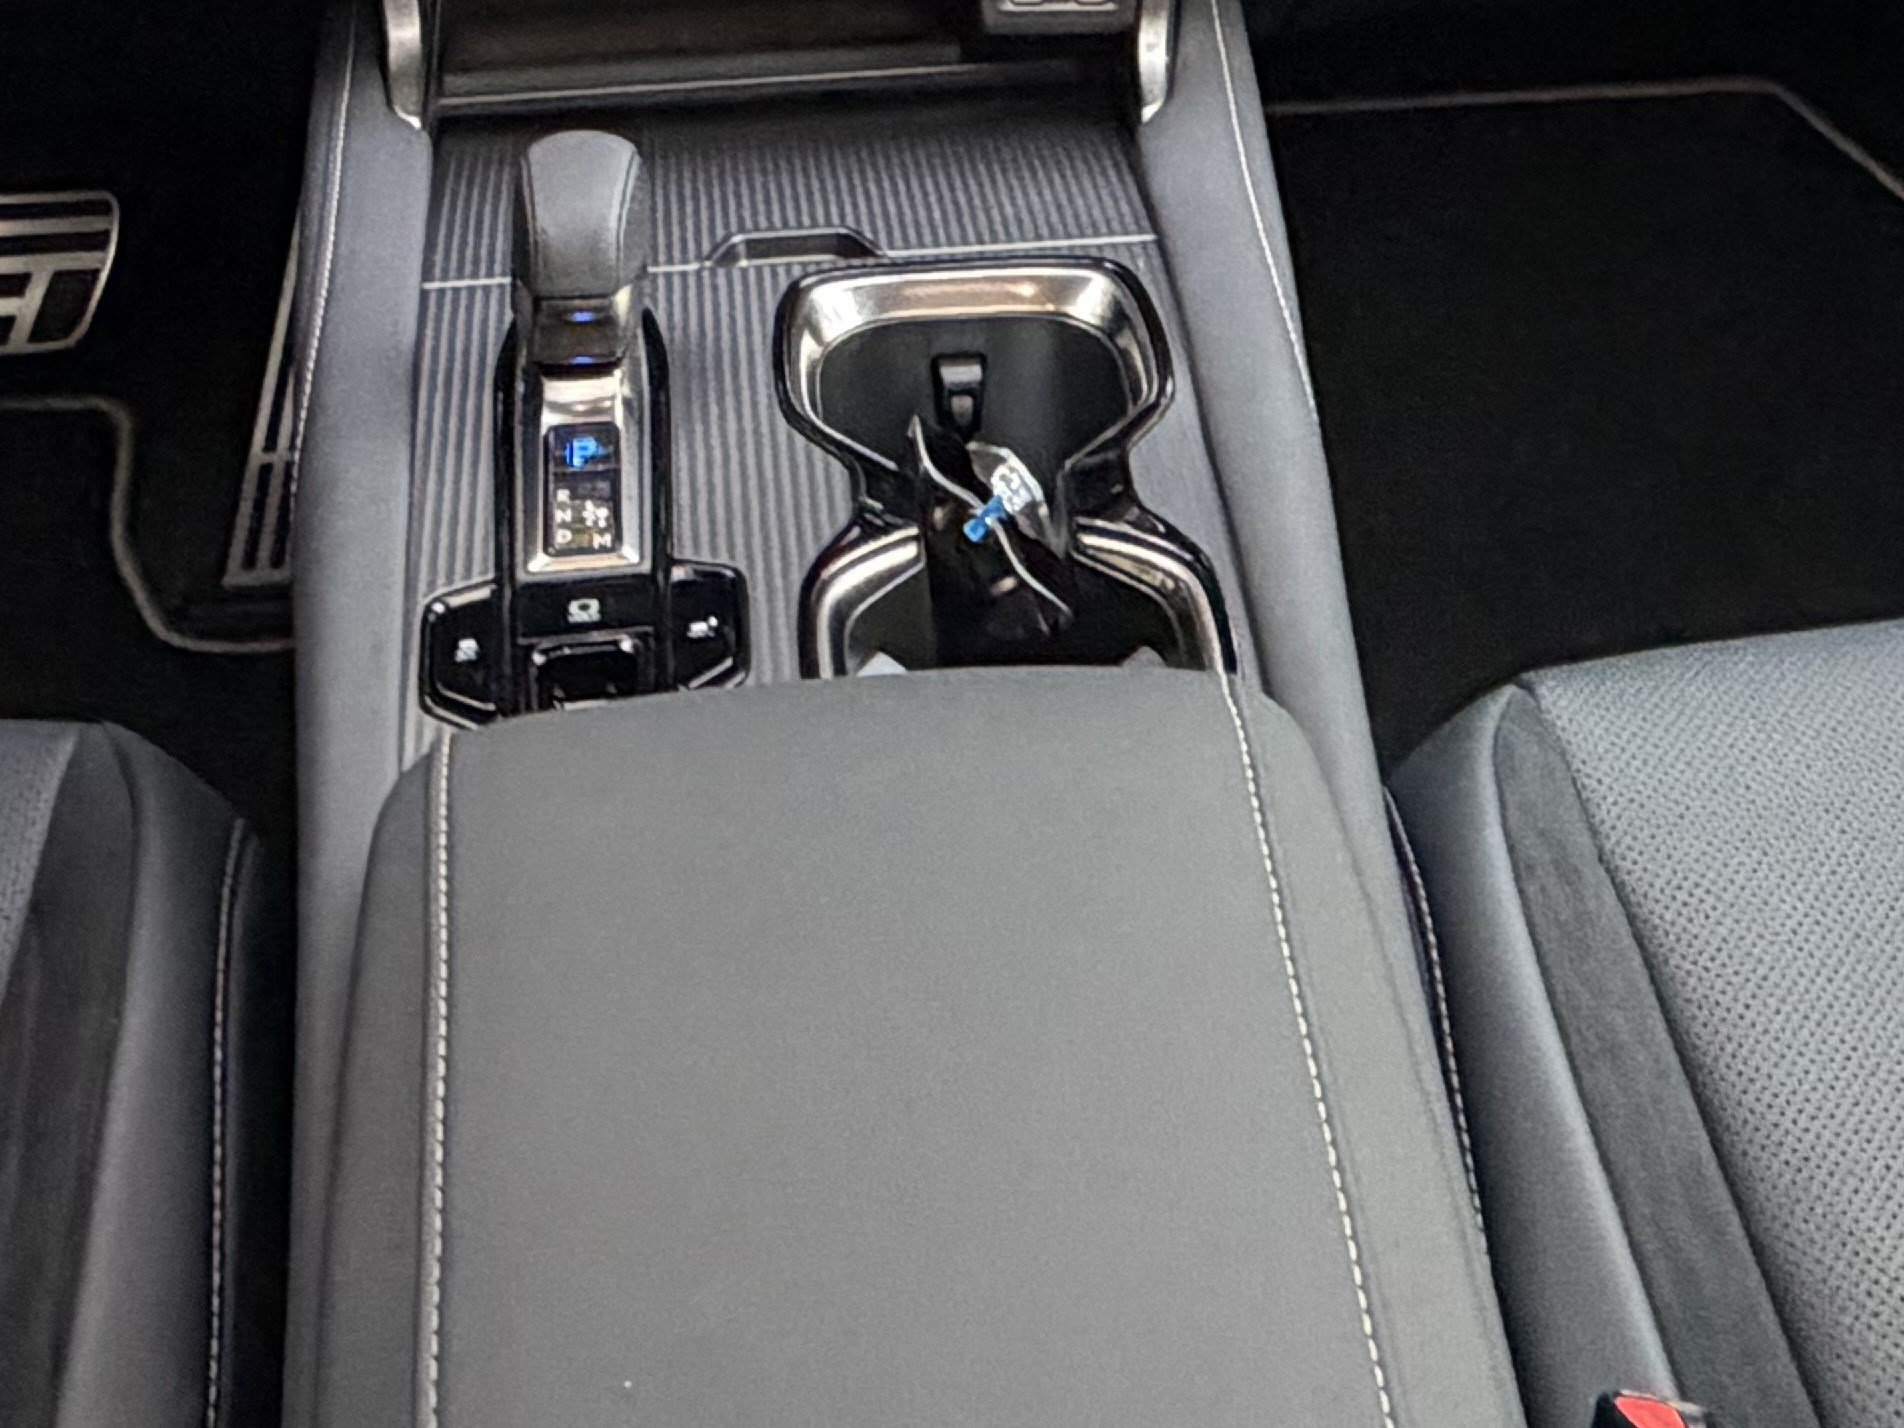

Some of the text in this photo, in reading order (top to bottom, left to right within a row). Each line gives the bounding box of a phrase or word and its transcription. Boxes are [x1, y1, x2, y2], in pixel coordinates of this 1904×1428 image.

[565, 435, 599, 470] P
[556, 508, 572, 524] N
[556, 528, 572, 545] D
[592, 532, 613, 550] M
